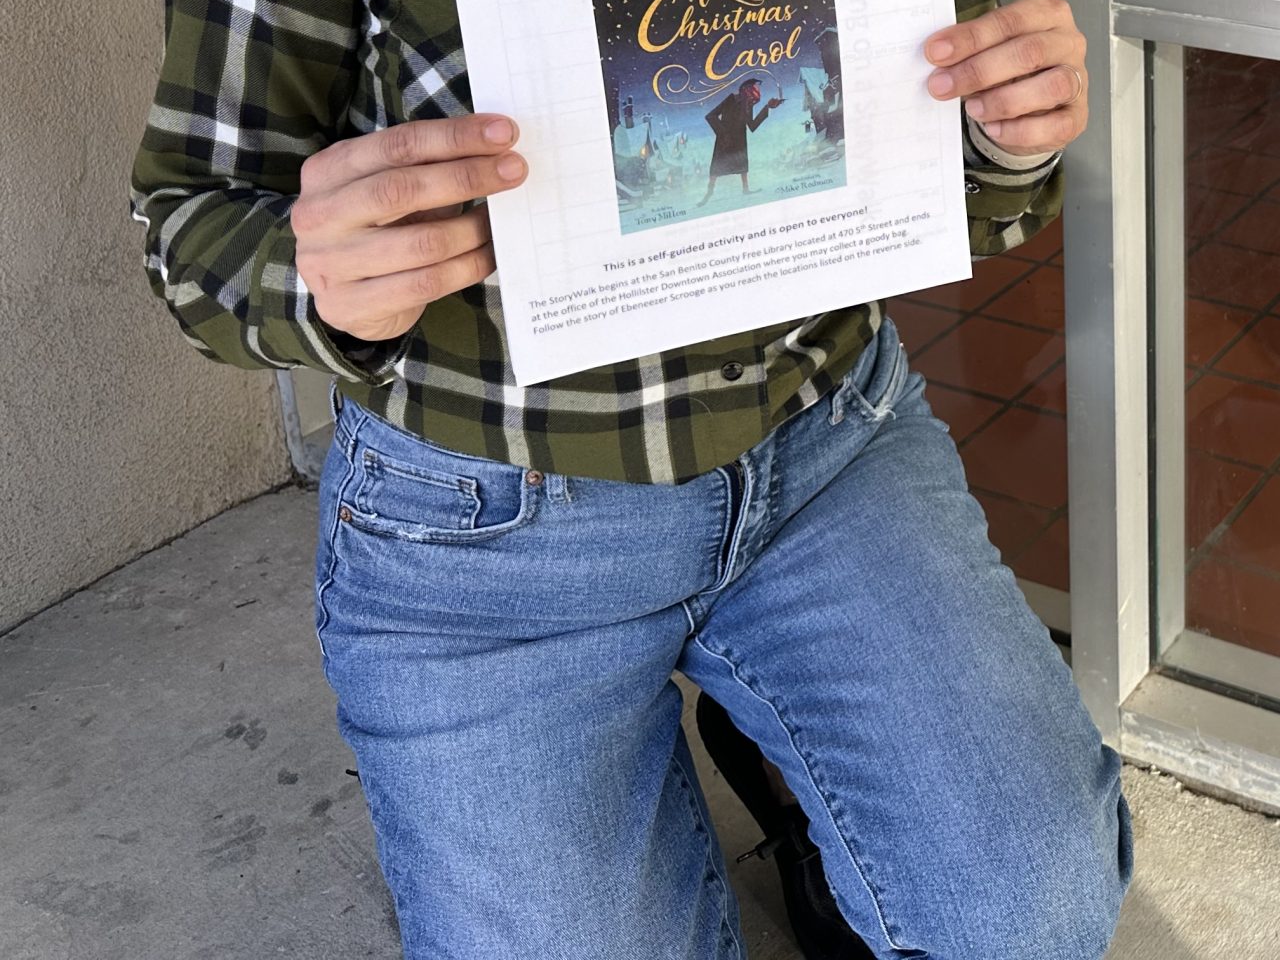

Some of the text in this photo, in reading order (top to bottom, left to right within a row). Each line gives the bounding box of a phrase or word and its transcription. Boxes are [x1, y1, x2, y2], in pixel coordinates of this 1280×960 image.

[705, 26, 801, 80] Carol
[527, 299, 547, 310] The
[548, 285, 598, 305] StoryWalk
[597, 279, 629, 293] begins
[629, 275, 641, 286] at
[640, 272, 658, 283] the
[658, 268, 676, 279] San
[676, 261, 708, 275] Benito
[707, 254, 741, 268] County
[741, 249, 762, 260] Free
[762, 242, 793, 256] Library
[793, 232, 827, 248] located
[826, 231, 837, 241] at
[837, 227, 855, 238] 470
[866, 219, 893, 232] Street
[893, 214, 910, 226] and
[910, 210, 931, 222] ends
[602, 204, 868, 272] This is a self-guided activity and is open to everyone!
